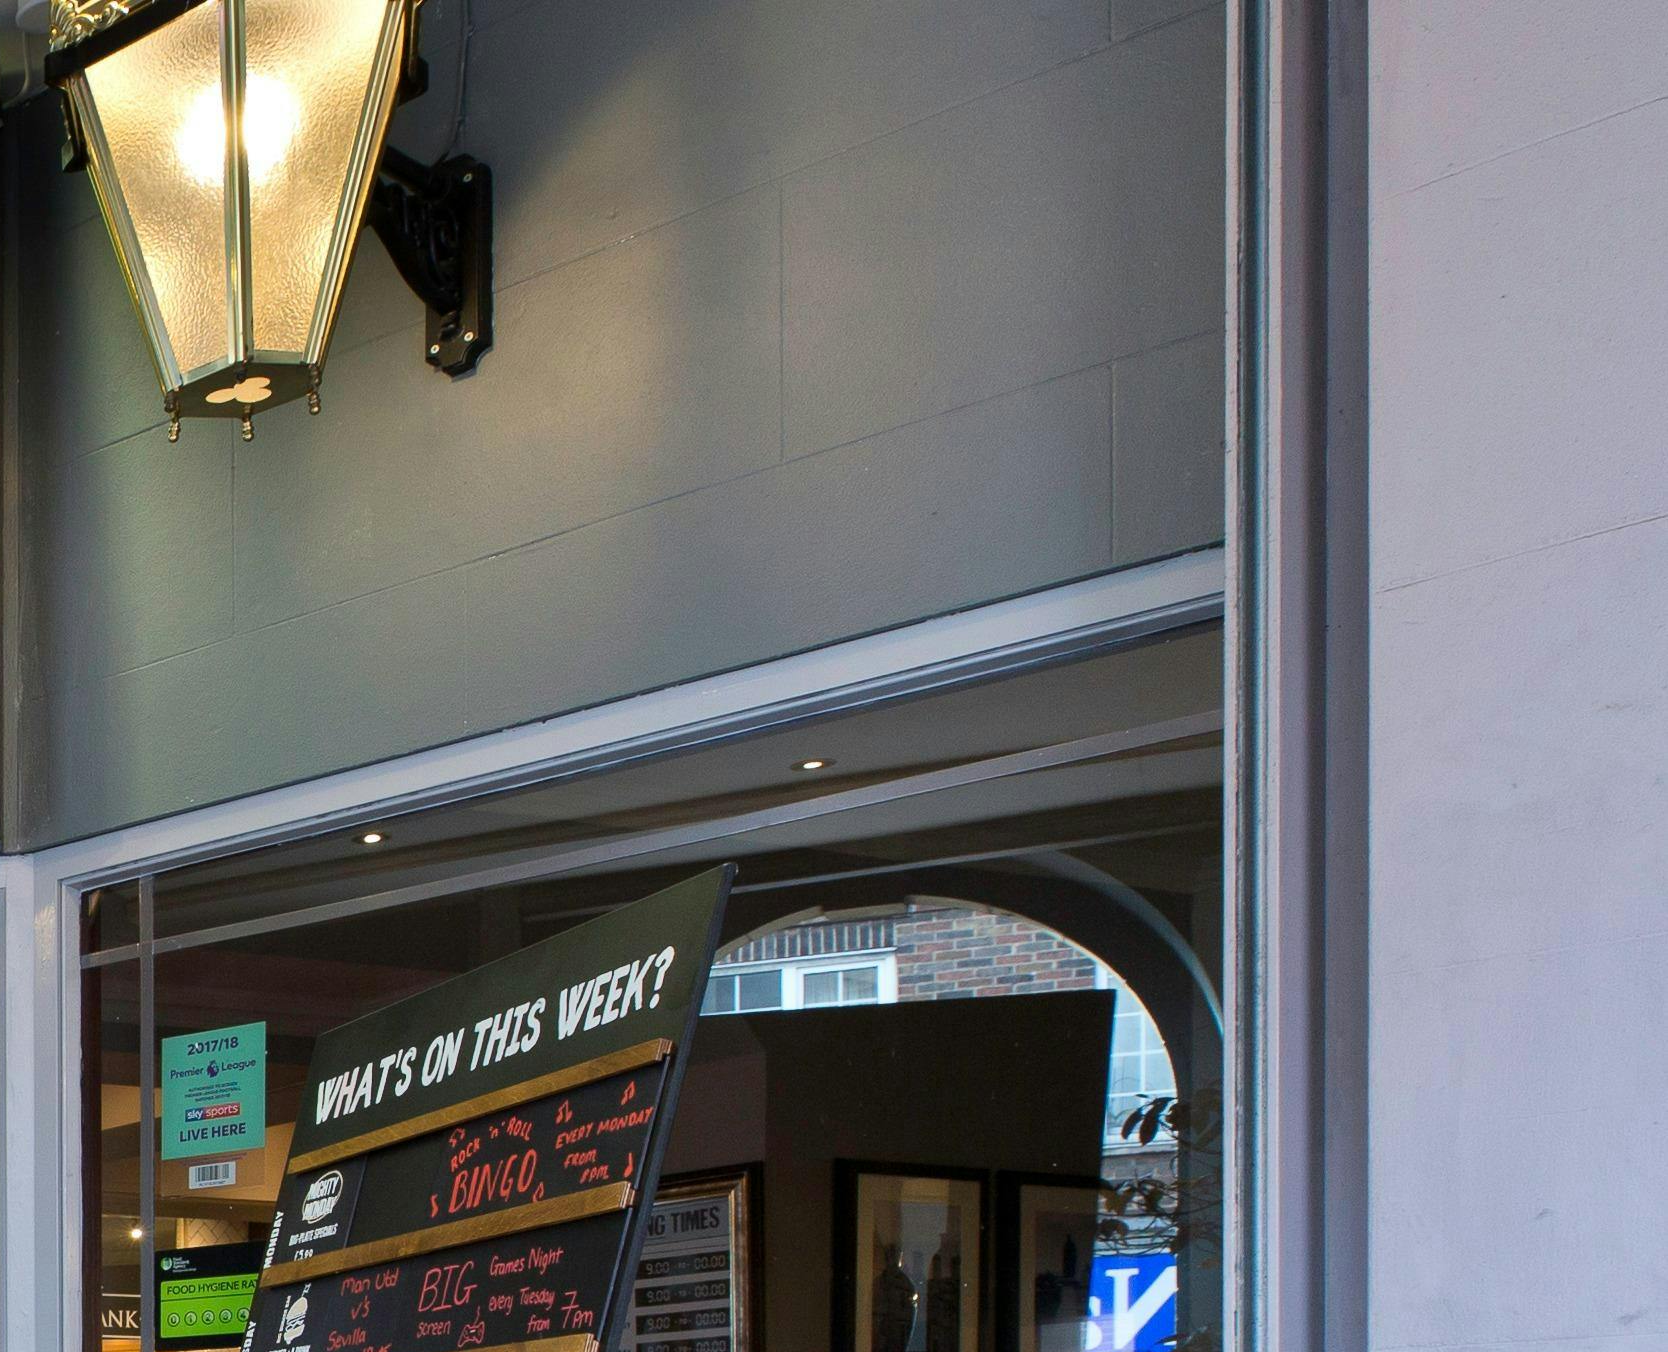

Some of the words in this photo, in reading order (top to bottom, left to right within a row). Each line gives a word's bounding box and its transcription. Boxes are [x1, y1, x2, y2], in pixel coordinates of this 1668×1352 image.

[187, 1037, 238, 1055] 2017/18
[316, 1046, 417, 1125] WHAT'S
[421, 1027, 464, 1086] ON
[469, 997, 546, 1071] THIS
[558, 945, 675, 1040] WEEK?
[171, 1066, 204, 1079] Premier
[222, 1059, 256, 1071] League
[187, 1109, 203, 1120] sky
[206, 1104, 239, 1118] sports
[180, 1128, 208, 1142] LIVE
[212, 1123, 246, 1138] HERE
[556, 1122, 592, 1149] EVERY
[597, 1106, 653, 1135] MONDAY
[448, 1149, 537, 1214] BINGO
[671, 1206, 720, 1234] TIMES
[263, 1211, 284, 1269] MONDAY
[489, 1255, 524, 1277] Games
[528, 1248, 563, 1275] Night
[167, 1285, 196, 1296] FOOD
[198, 1283, 239, 1293] HYGIENE
[418, 1260, 477, 1312] BIG
[489, 1295, 513, 1315] every
[520, 1286, 555, 1311] Tuesday
[327, 1327, 366, 1352] Sevilla
[417, 1320, 450, 1339] screen
